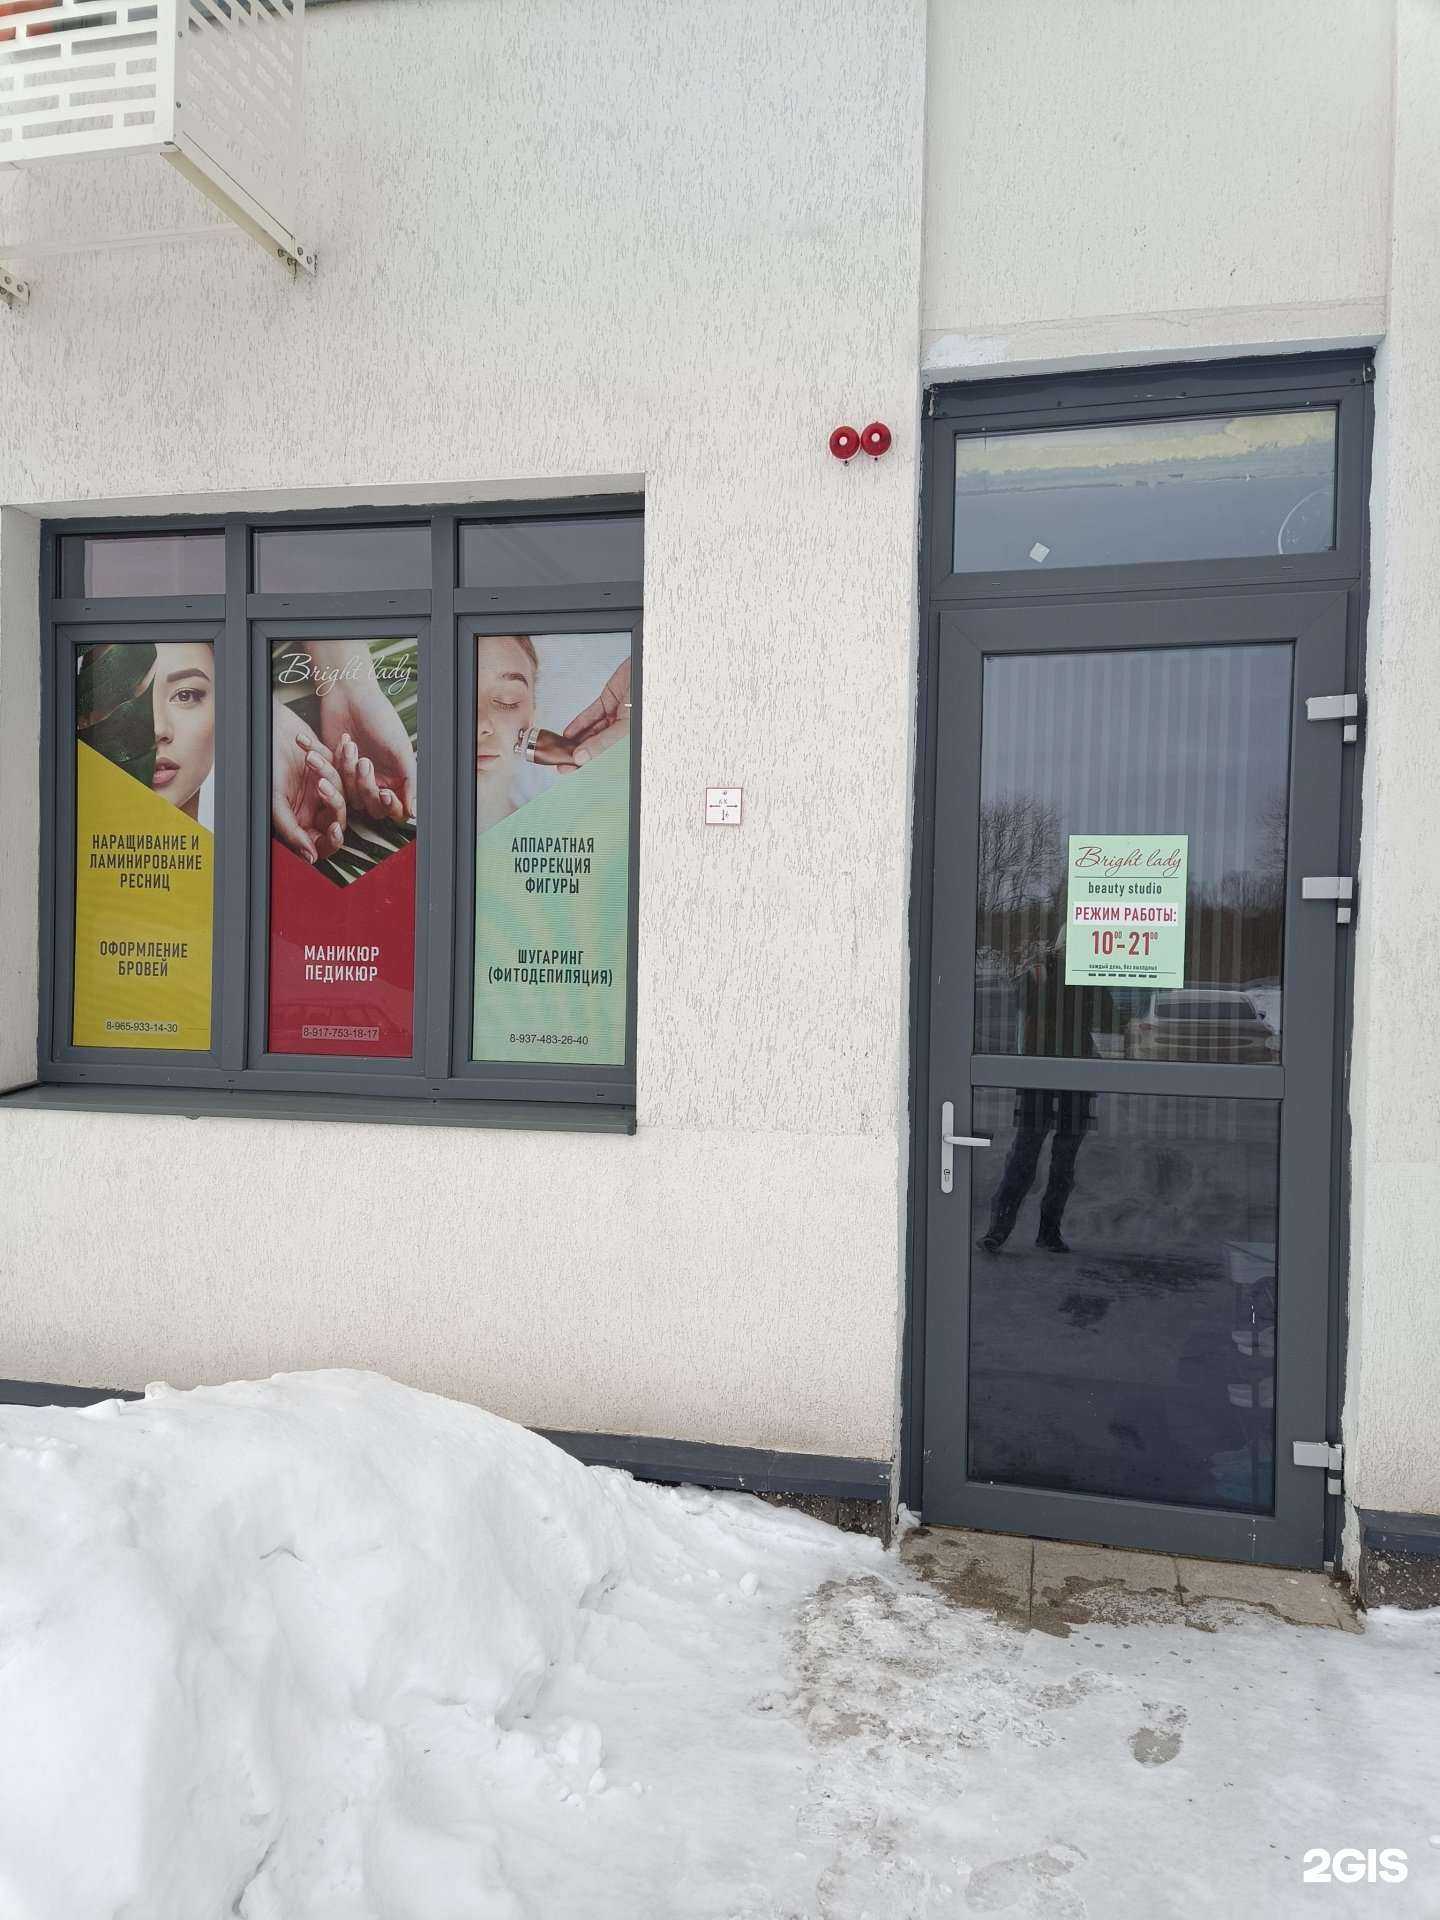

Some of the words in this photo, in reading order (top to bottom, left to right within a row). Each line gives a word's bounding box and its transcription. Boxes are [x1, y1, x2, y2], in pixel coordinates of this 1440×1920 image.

[278, 652, 364, 697] Bright
[366, 653, 413, 696] lady
[92, 833, 187, 852] НАРАЩИВАНИЕ
[191, 834, 200, 850] И
[511, 836, 595, 853] АППАРАТНАЯ
[89, 853, 203, 870] ЛАМИНИРОВАНИЕ
[513, 857, 592, 876] КОРРЕКЦИЯ
[1074, 846, 1144, 877] Bright
[1146, 848, 1182, 877] lady
[119, 873, 171, 892] РЕСНИЦ
[525, 877, 580, 894] ФИГУРЫ
[1088, 882, 1125, 897] beauty
[1128, 882, 1162, 895] studio
[1075, 906, 1120, 921] РЕЖИМ
[1124, 907, 1177, 922] РАБОТЫ:
[99, 940, 188, 958] ОФОРМЛЕНИЕ
[304, 945, 380, 962] МАНИКЮР
[518, 949, 584, 965] ШУГАРИНГ
[118, 958, 168, 977] БРОВЕЙ
[305, 965, 378, 983] ПЕДИКЮР
[488, 966, 613, 987] (ФИТОДЕПИЛЯЦИЯ)
[106, 1021, 178, 1032] 8-965-933-14-30
[303, 1027, 378, 1039] 8-917-753-18-17
